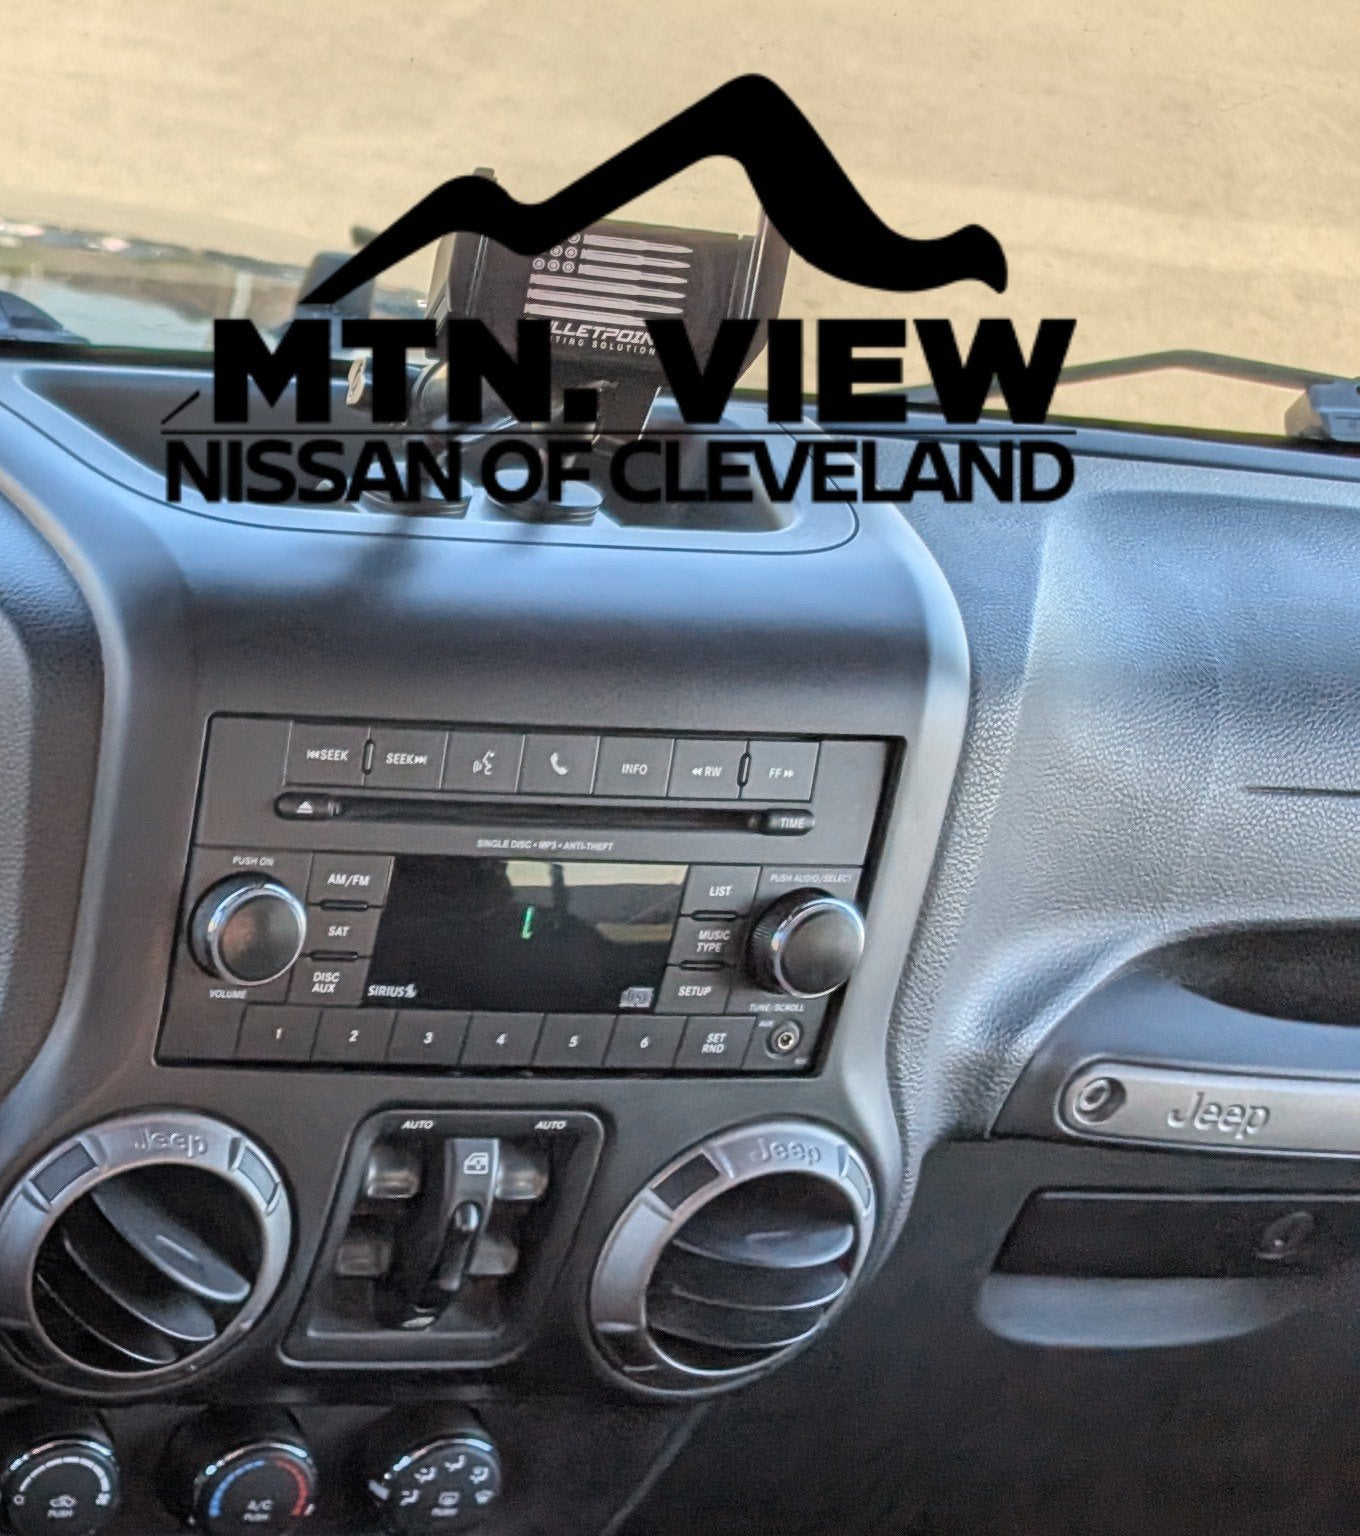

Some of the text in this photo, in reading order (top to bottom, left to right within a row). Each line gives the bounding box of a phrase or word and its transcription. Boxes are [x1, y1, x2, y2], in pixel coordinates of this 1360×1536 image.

[591, 340, 656, 356] SOLUTION
[318, 749, 349, 761] SEEK
[386, 753, 414, 765] SEEK
[620, 763, 650, 775] INFO
[704, 766, 723, 778] RW
[768, 767, 783, 779] FF
[779, 817, 806, 829] TIME
[232, 855, 257, 866] PUSH
[327, 873, 370, 887] AM/FM
[709, 885, 732, 897] LIST
[327, 925, 350, 937] SAT
[698, 929, 730, 942] MUSIC
[696, 941, 722, 953] TYPE
[312, 971, 340, 983] DISC
[208, 988, 248, 999] VOLUME
[311, 982, 336, 994] AUX
[367, 984, 406, 998] SIRIUS
[677, 985, 713, 997] SETUP
[348, 1029, 360, 1043] 2
[422, 1031, 434, 1045] 3
[495, 1033, 508, 1046] 4
[568, 1035, 579, 1048] 5
[638, 1035, 651, 1049] 6
[706, 1032, 727, 1043] SET
[701, 1043, 726, 1055] RND
[1167, 1091, 1271, 1140] Jeep
[401, 1119, 434, 1130] AUTO
[535, 1119, 567, 1130] AUTO
[133, 1127, 209, 1159] Jeep
[748, 1137, 823, 1166] Jeep
